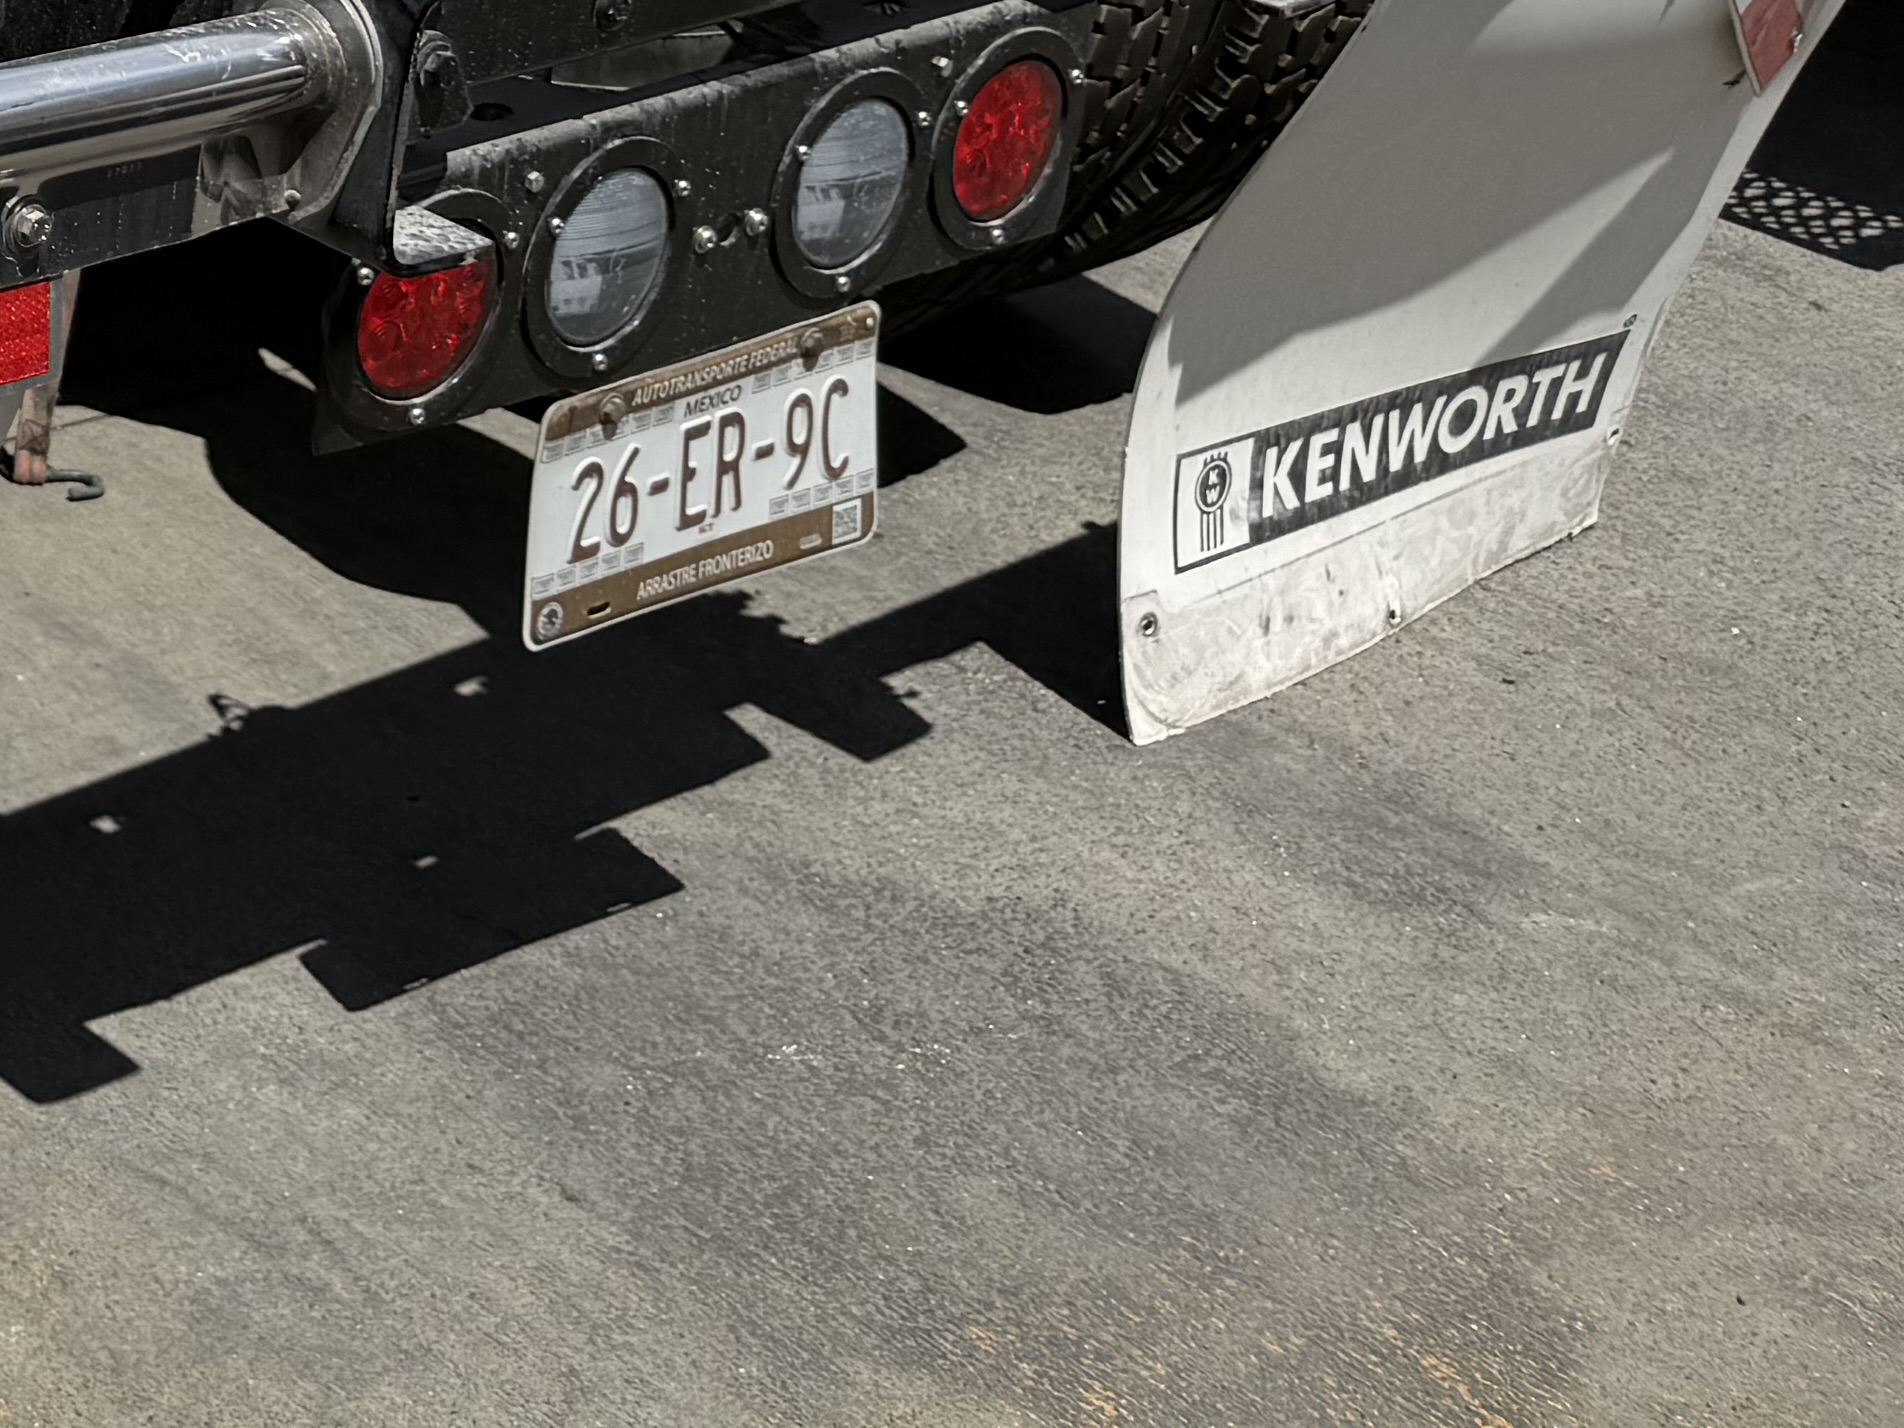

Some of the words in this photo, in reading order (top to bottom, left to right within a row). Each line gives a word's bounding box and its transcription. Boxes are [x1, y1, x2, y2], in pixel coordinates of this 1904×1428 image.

[632, 361, 748, 406] AUTOTRANSPORTE
[748, 337, 798, 369] FEDERAL
[683, 383, 743, 418] MEXICO
[1259, 350, 1606, 519] KENWORTH
[567, 377, 849, 565] 26-ER-9C
[637, 563, 698, 600] ARRASTRE
[698, 539, 774, 579] FRONTERIZO
